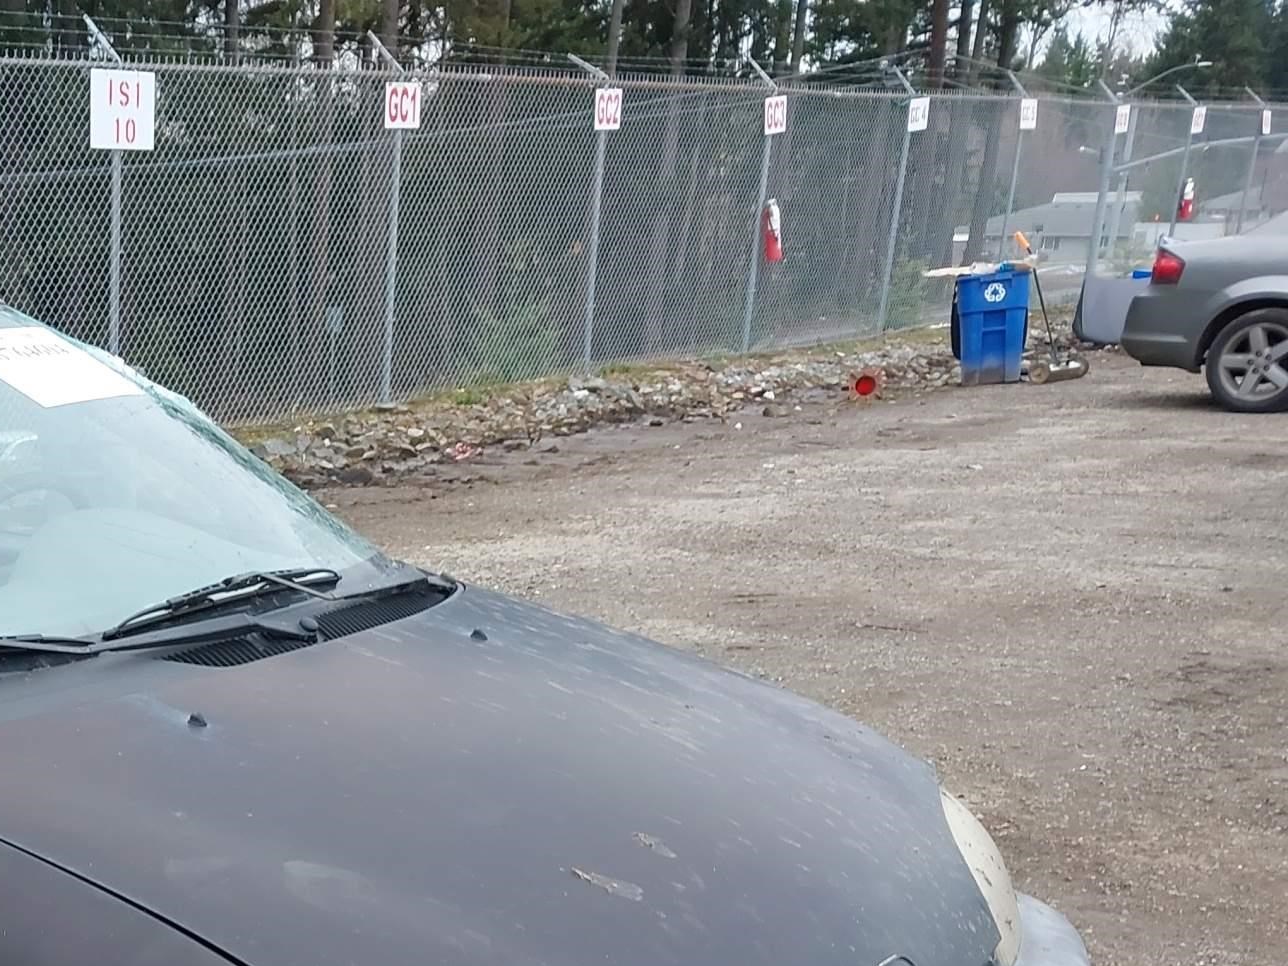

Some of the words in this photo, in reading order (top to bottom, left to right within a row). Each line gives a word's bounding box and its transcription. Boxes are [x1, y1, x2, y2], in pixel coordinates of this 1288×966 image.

[388, 86, 418, 123] GC1
[597, 93, 620, 125] GC2
[767, 100, 785, 129] GC3
[115, 117, 136, 144] 10
